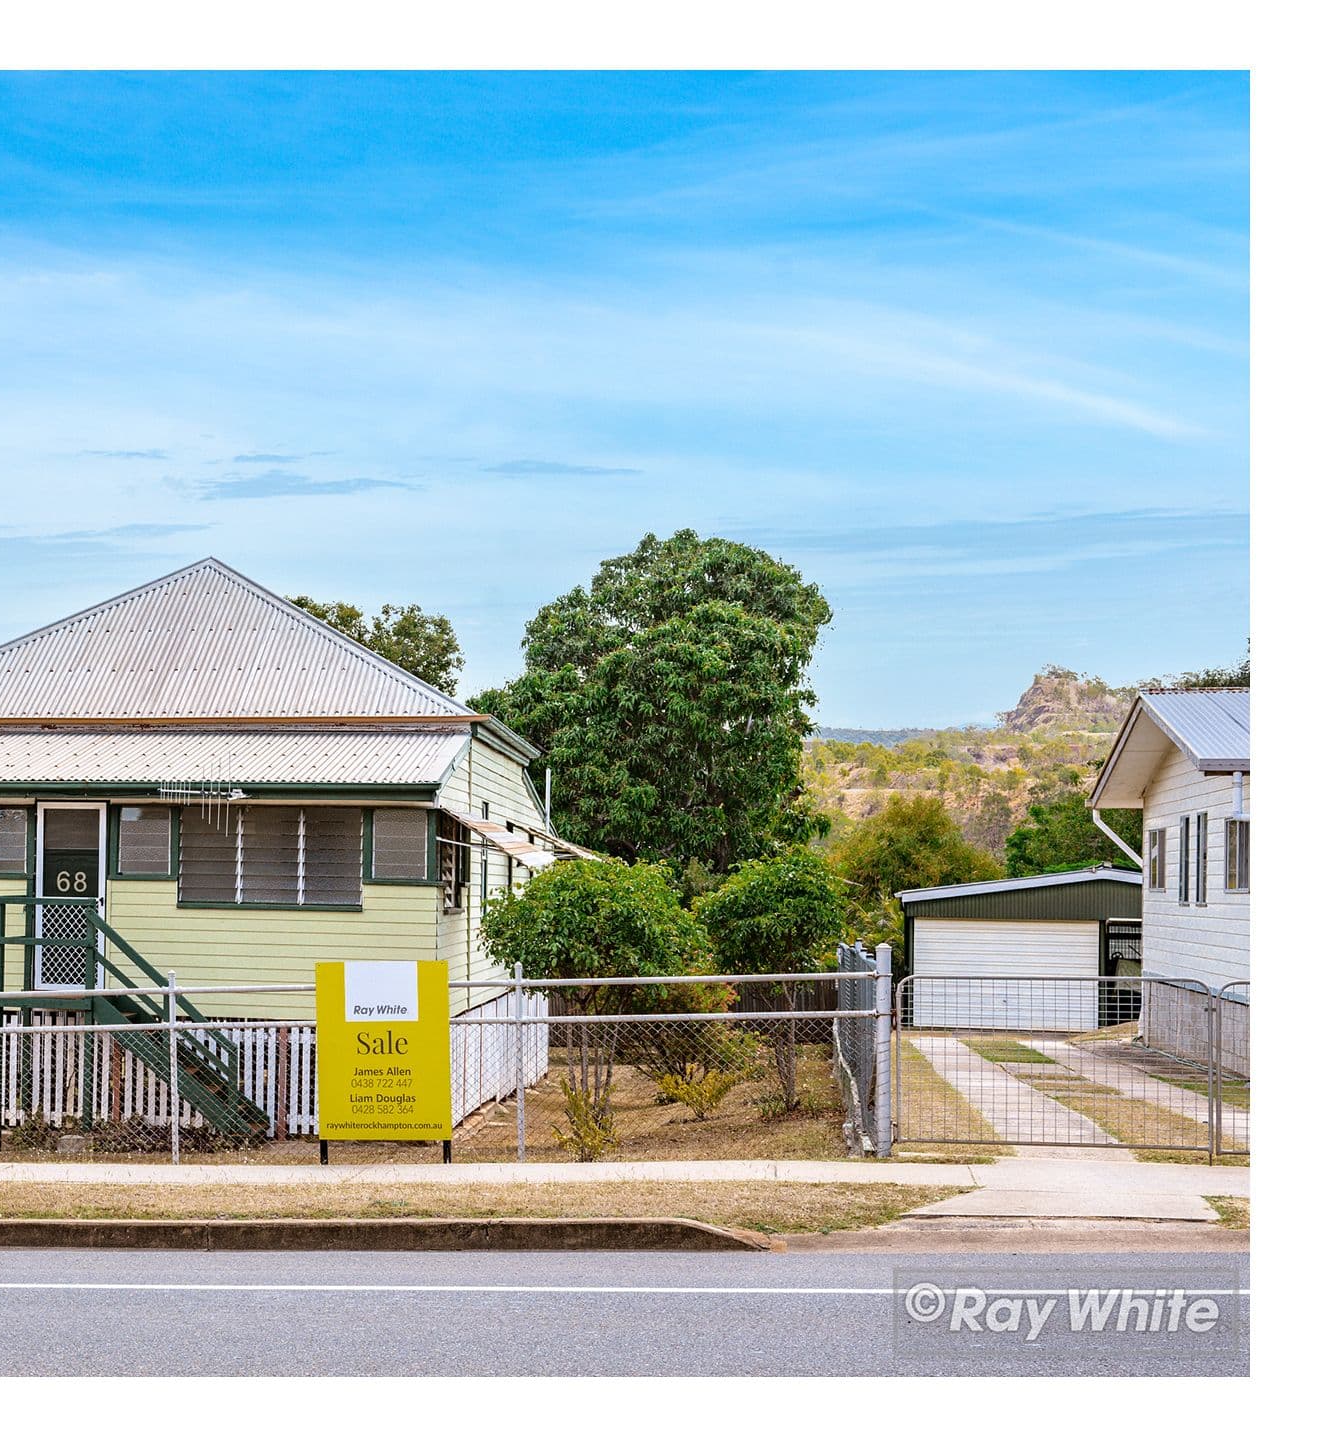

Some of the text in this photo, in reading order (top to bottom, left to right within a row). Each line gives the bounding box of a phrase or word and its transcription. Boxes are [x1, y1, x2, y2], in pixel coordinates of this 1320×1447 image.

[57, 870, 87, 892] 68
[353, 1004, 408, 1016] Ray White
[357, 1030, 408, 1055] Sale
[354, 1067, 411, 1076] James Allen
[351, 1079, 412, 1088] 0438 722 447
[350, 1094, 416, 1104] Liam Douglas
[352, 1105, 414, 1114] 0428 582 364
[326, 1121, 443, 1130] raywhiterockhampton.com.au
